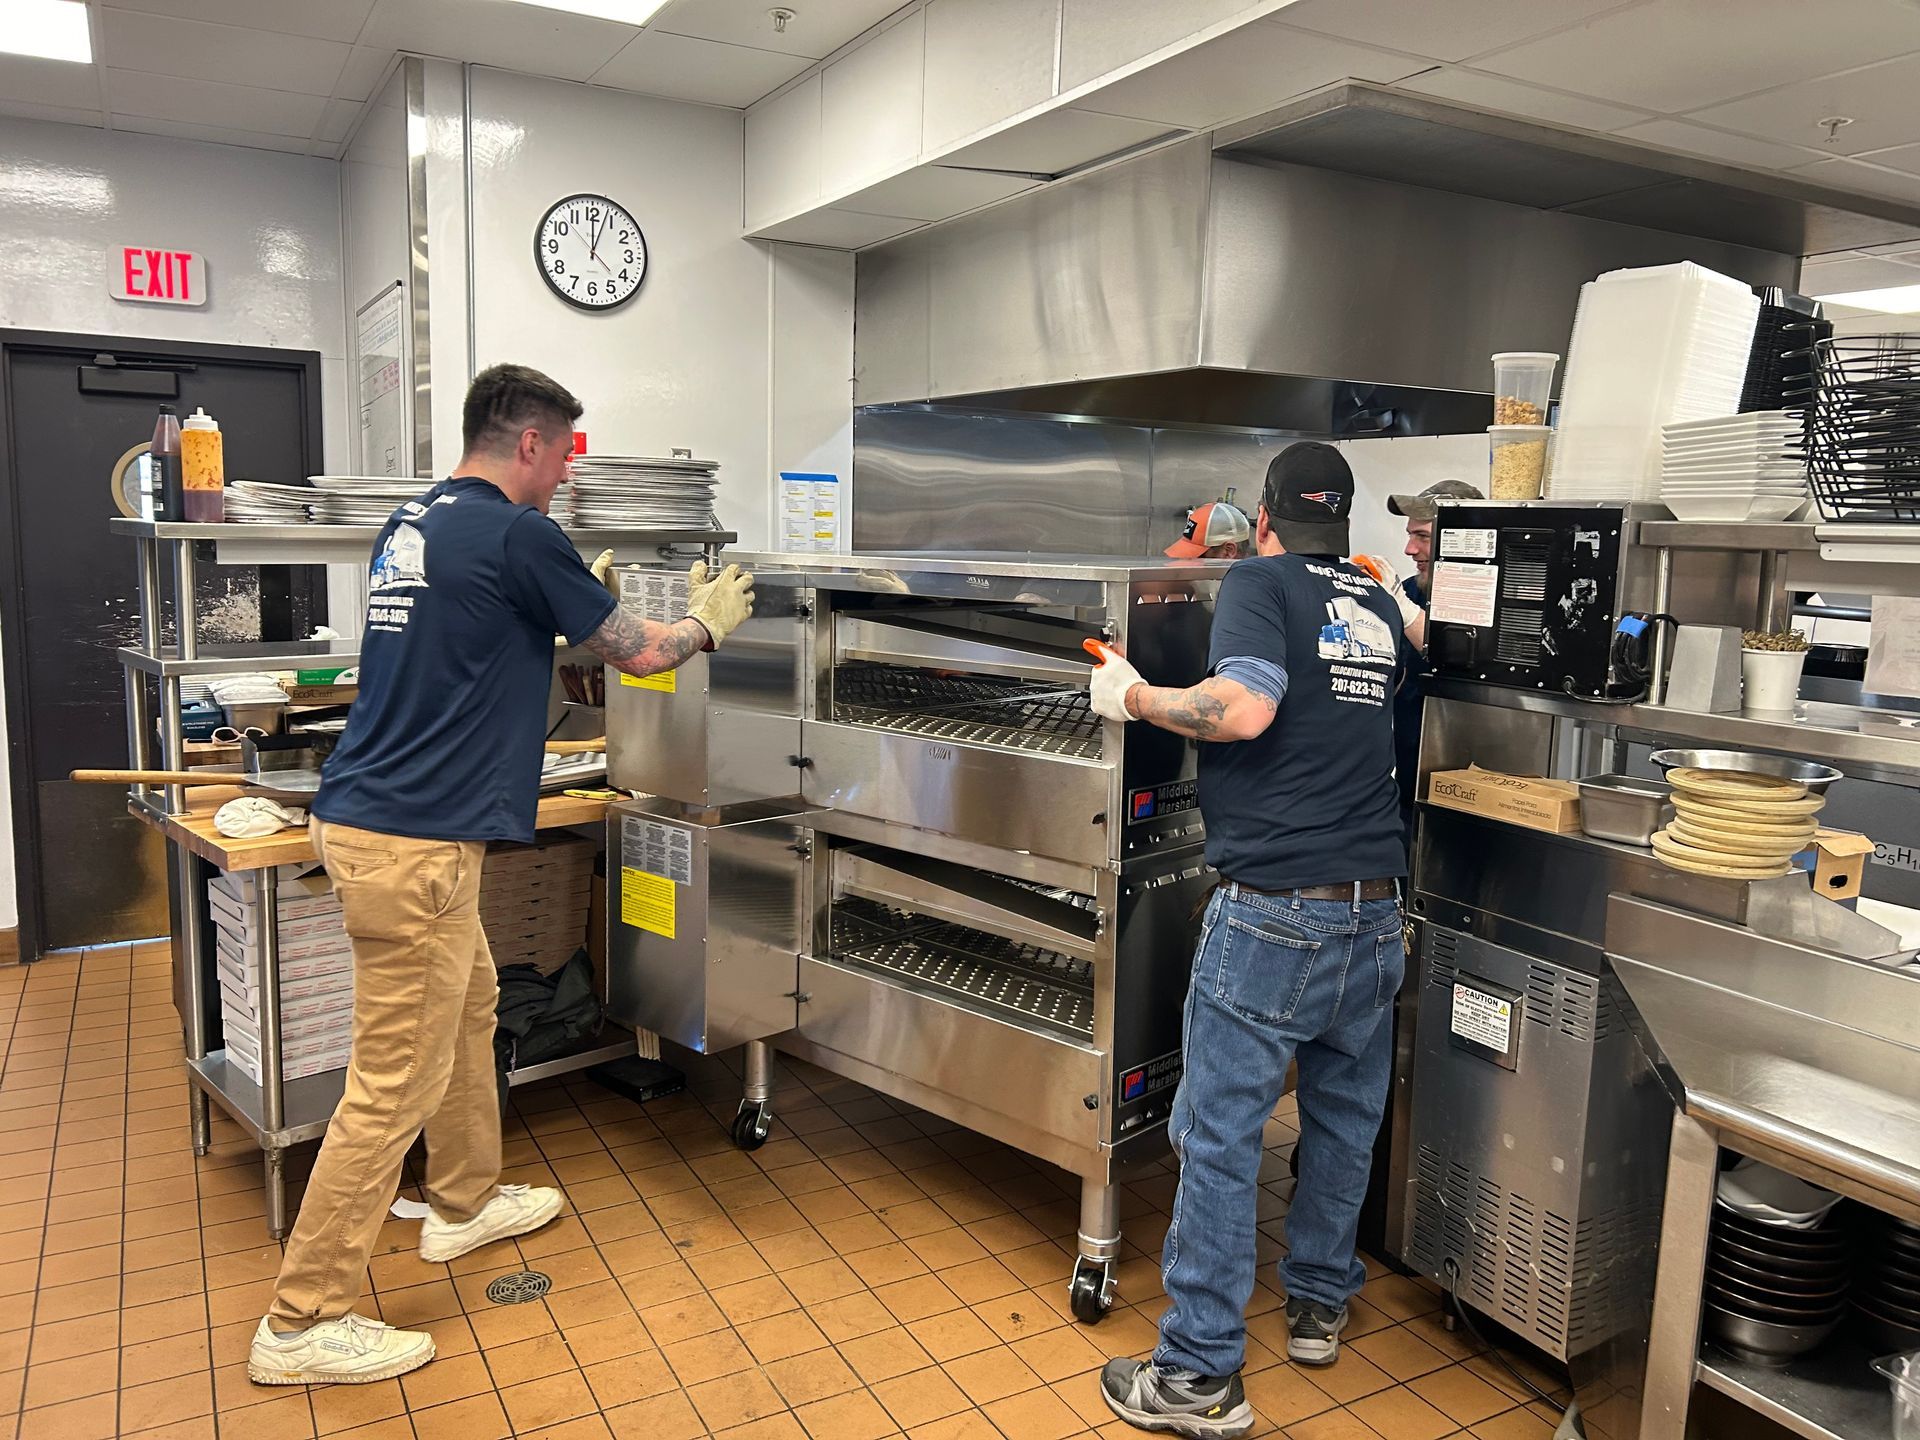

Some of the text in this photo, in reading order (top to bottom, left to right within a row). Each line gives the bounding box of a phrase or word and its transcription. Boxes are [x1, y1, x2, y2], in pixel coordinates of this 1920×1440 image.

[570, 209, 579, 225] 11
[586, 206, 600, 222] 12
[609, 214, 613, 229] 1
[554, 220, 569, 236] 10
[618, 229, 629, 245] 2
[548, 238, 559, 254] 9
[623, 249, 634, 264] 3
[123, 247, 192, 300] EXIT
[554, 259, 565, 275] 8
[618, 268, 629, 282] 4
[569, 275, 580, 290] 7
[587, 281, 598, 296] 6
[605, 279, 616, 294] 5
[1329, 664, 1362, 678] RELOCATION
[1157, 796, 1197, 815] Marshall
[1873, 843, 1920, 870] C5H1
[1465, 989, 1498, 1007] CAUTION
